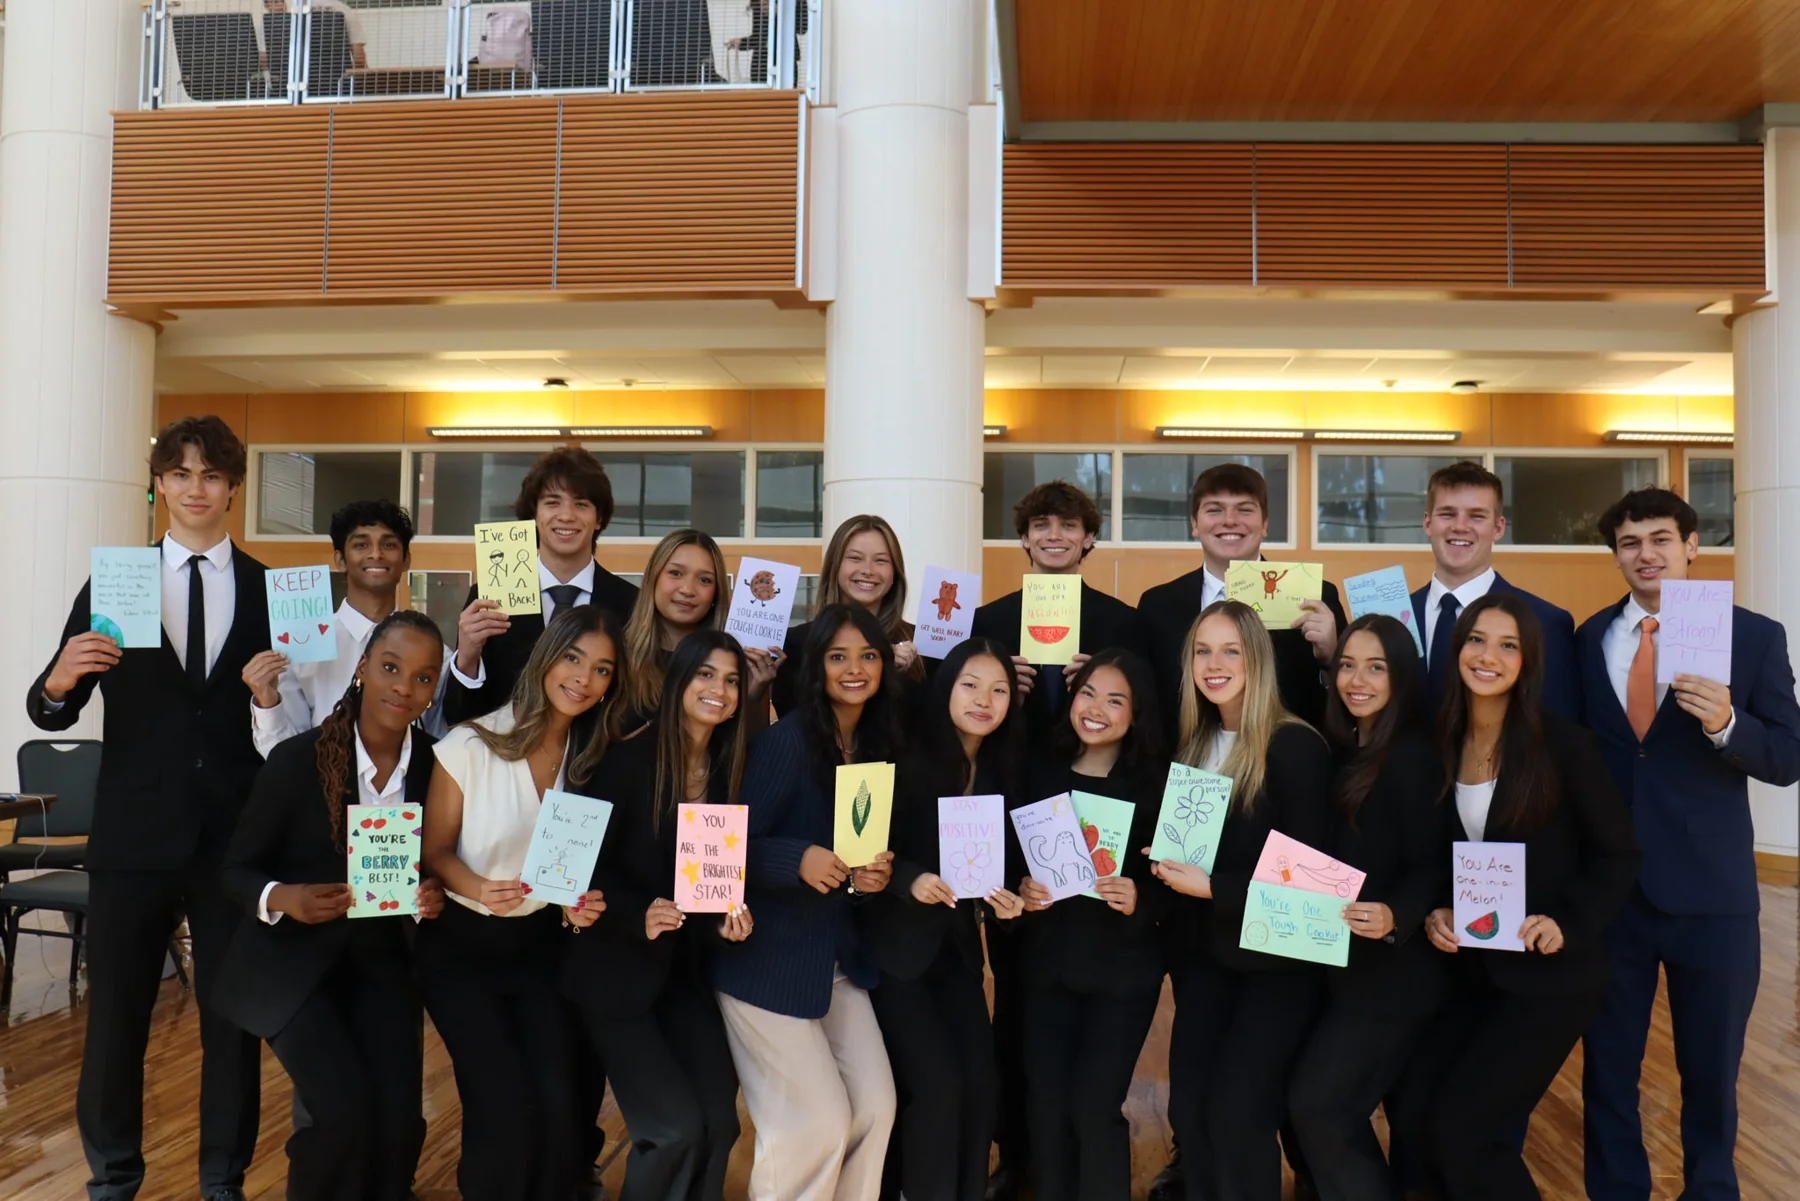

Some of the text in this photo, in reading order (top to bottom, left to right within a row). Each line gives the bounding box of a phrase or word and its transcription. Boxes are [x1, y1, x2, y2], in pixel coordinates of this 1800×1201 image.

[510, 526, 528, 542] Got
[273, 570, 322, 592] KEEP
[271, 596, 328, 620] GOING!
[752, 610, 769, 620] ARE
[769, 613, 785, 623] ONE
[729, 618, 783, 641] TOUGH COOKIE
[952, 800, 979, 811] STAY
[702, 814, 726, 829] YOU
[941, 823, 999, 838] POSITIVE
[368, 834, 407, 844] YOU'RE
[680, 842, 719, 857] ARE THE
[362, 855, 409, 870] BERRY
[1487, 856, 1513, 873] Are
[368, 873, 399, 884] BEST!
[703, 863, 742, 880] BRIGHTEST
[693, 884, 732, 901] STAR!
[1260, 889, 1322, 917] You're One
[1268, 916, 1344, 940] Tough Cookie!
